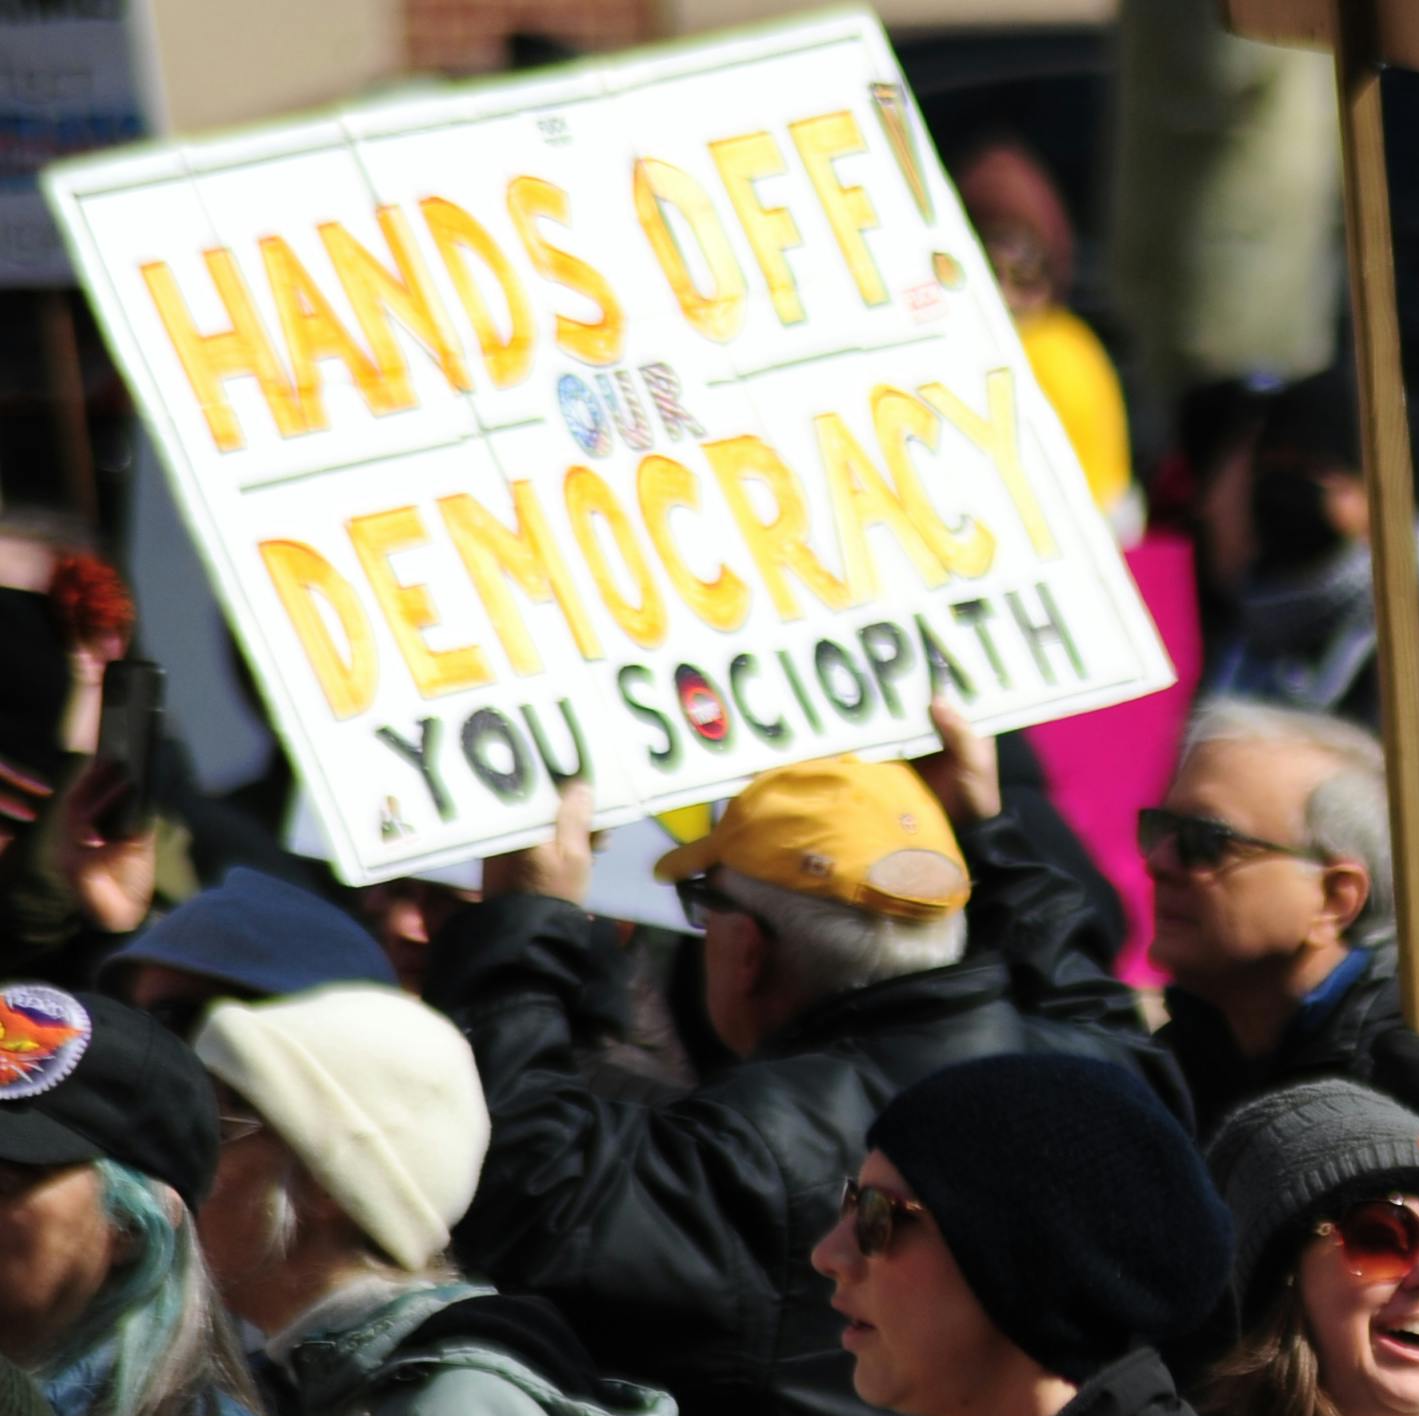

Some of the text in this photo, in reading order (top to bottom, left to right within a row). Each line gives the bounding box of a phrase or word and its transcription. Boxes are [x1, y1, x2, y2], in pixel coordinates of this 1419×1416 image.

[139, 82, 966, 452] HANDS OFF!
[556, 361, 706, 457] OUR
[258, 366, 1061, 722] DEMOCRACY
[376, 582, 1087, 824] YOU SOCIOPATH
